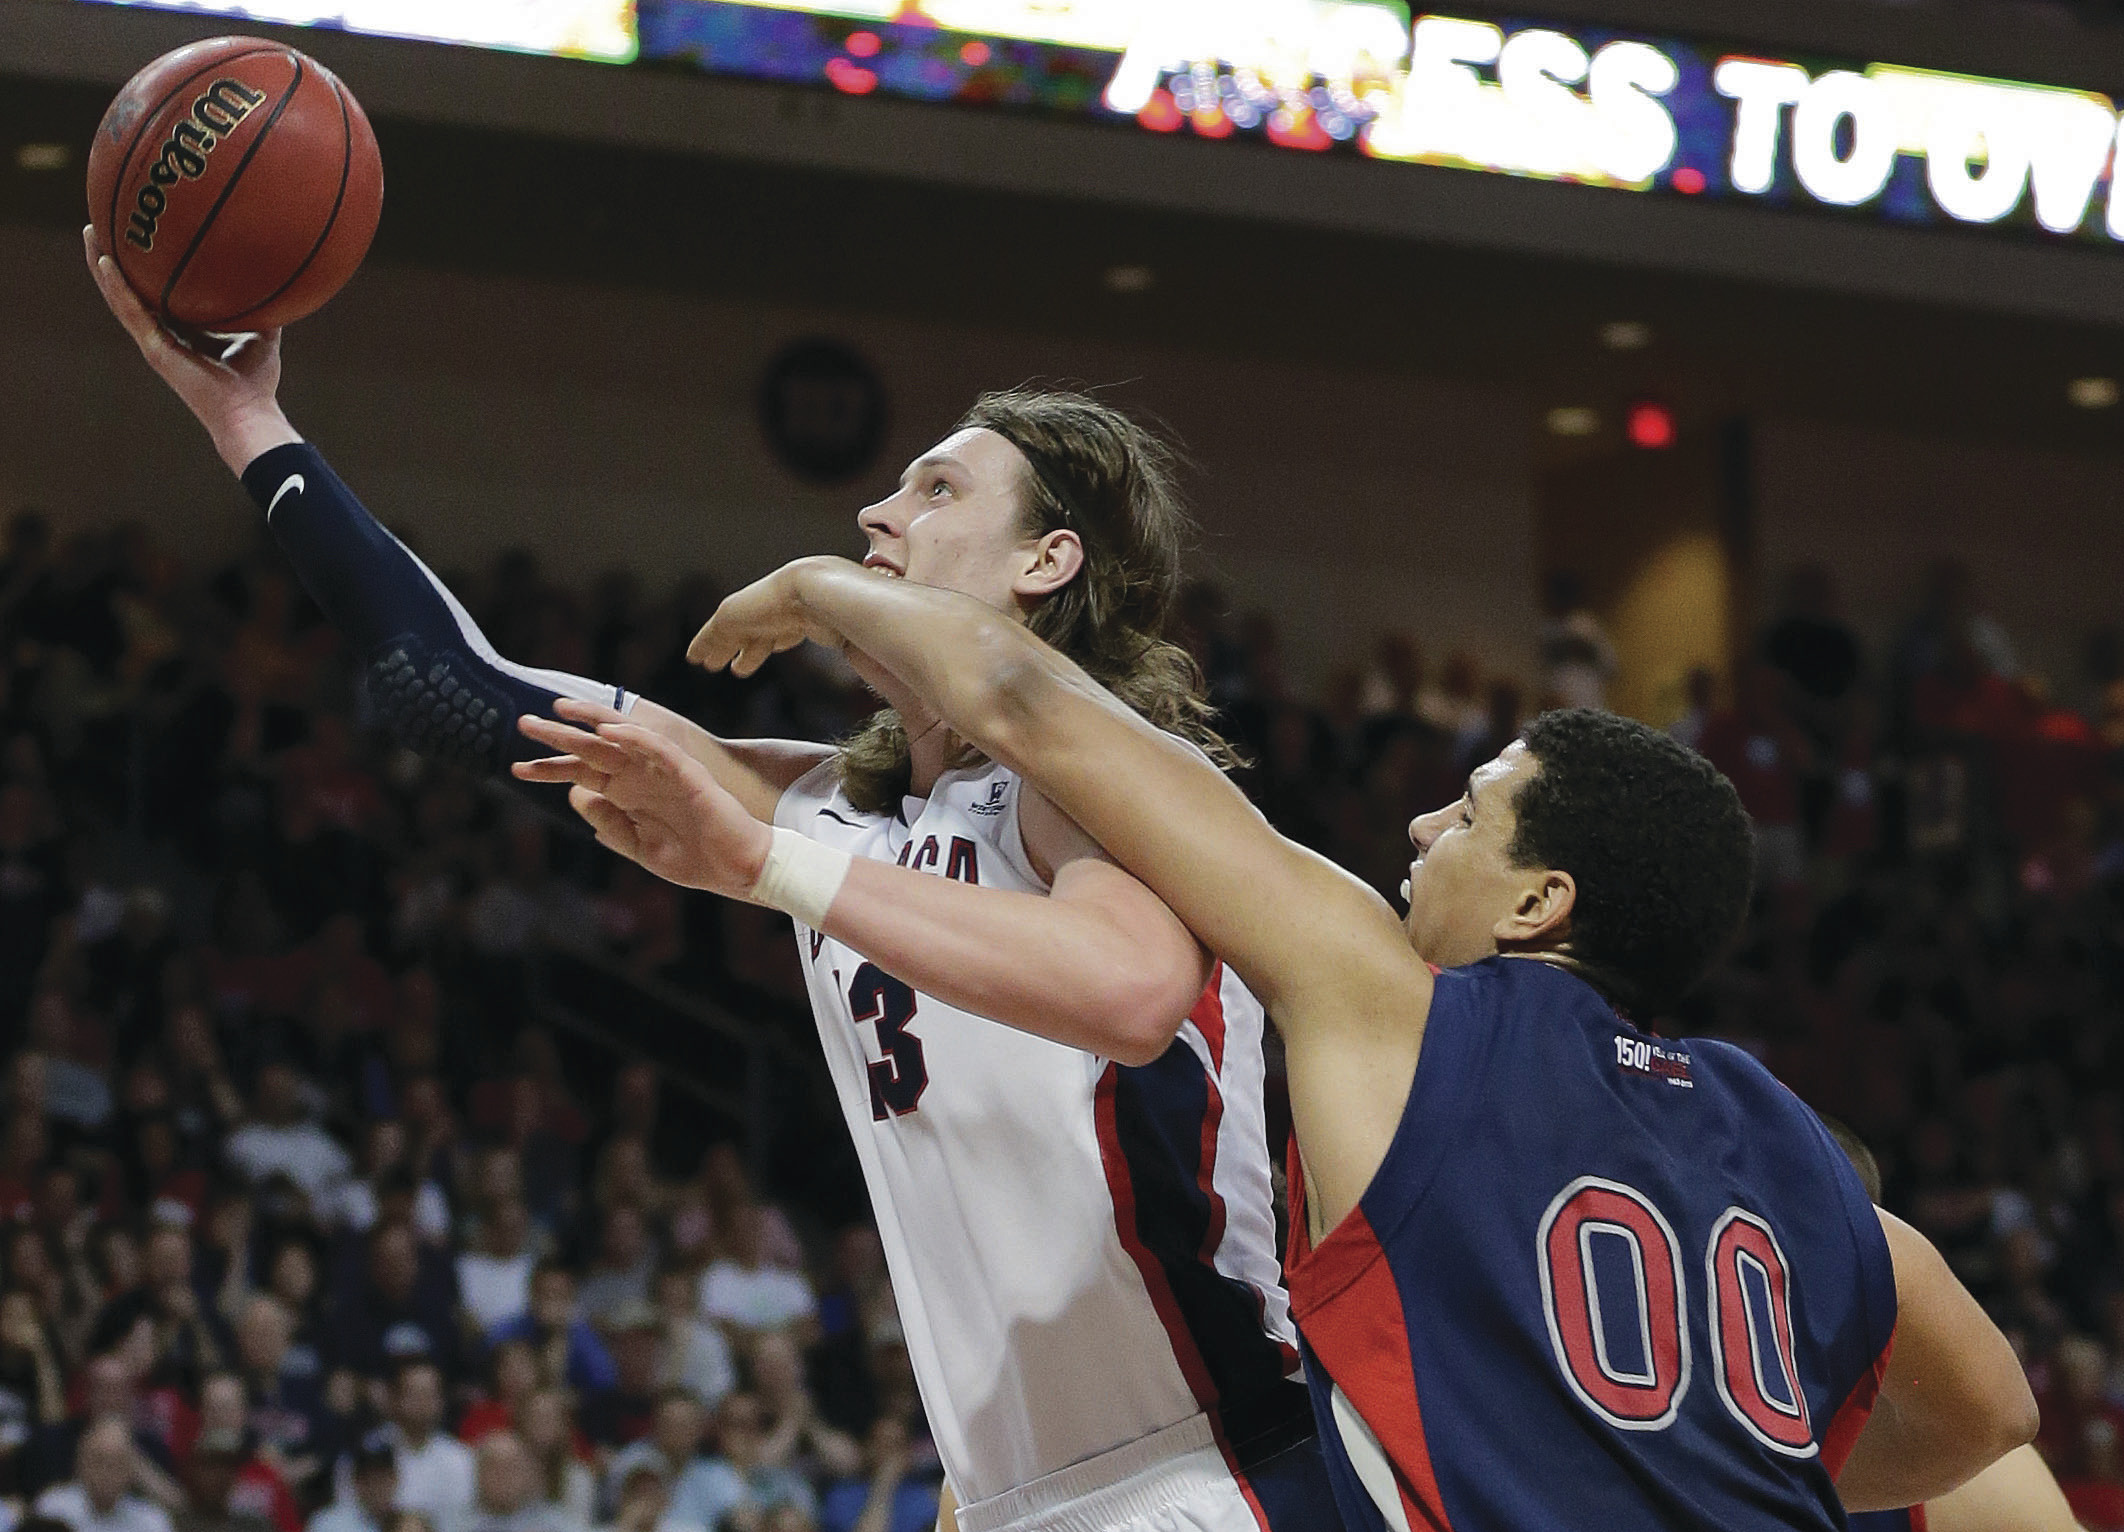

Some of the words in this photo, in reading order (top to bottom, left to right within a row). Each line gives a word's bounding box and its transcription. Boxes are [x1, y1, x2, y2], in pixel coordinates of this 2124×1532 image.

[125, 77, 267, 252] Wilson
[1713, 59, 1896, 206] TO
[1926, 82, 2124, 243] OV
[1536, 1175, 1819, 1459] 00
